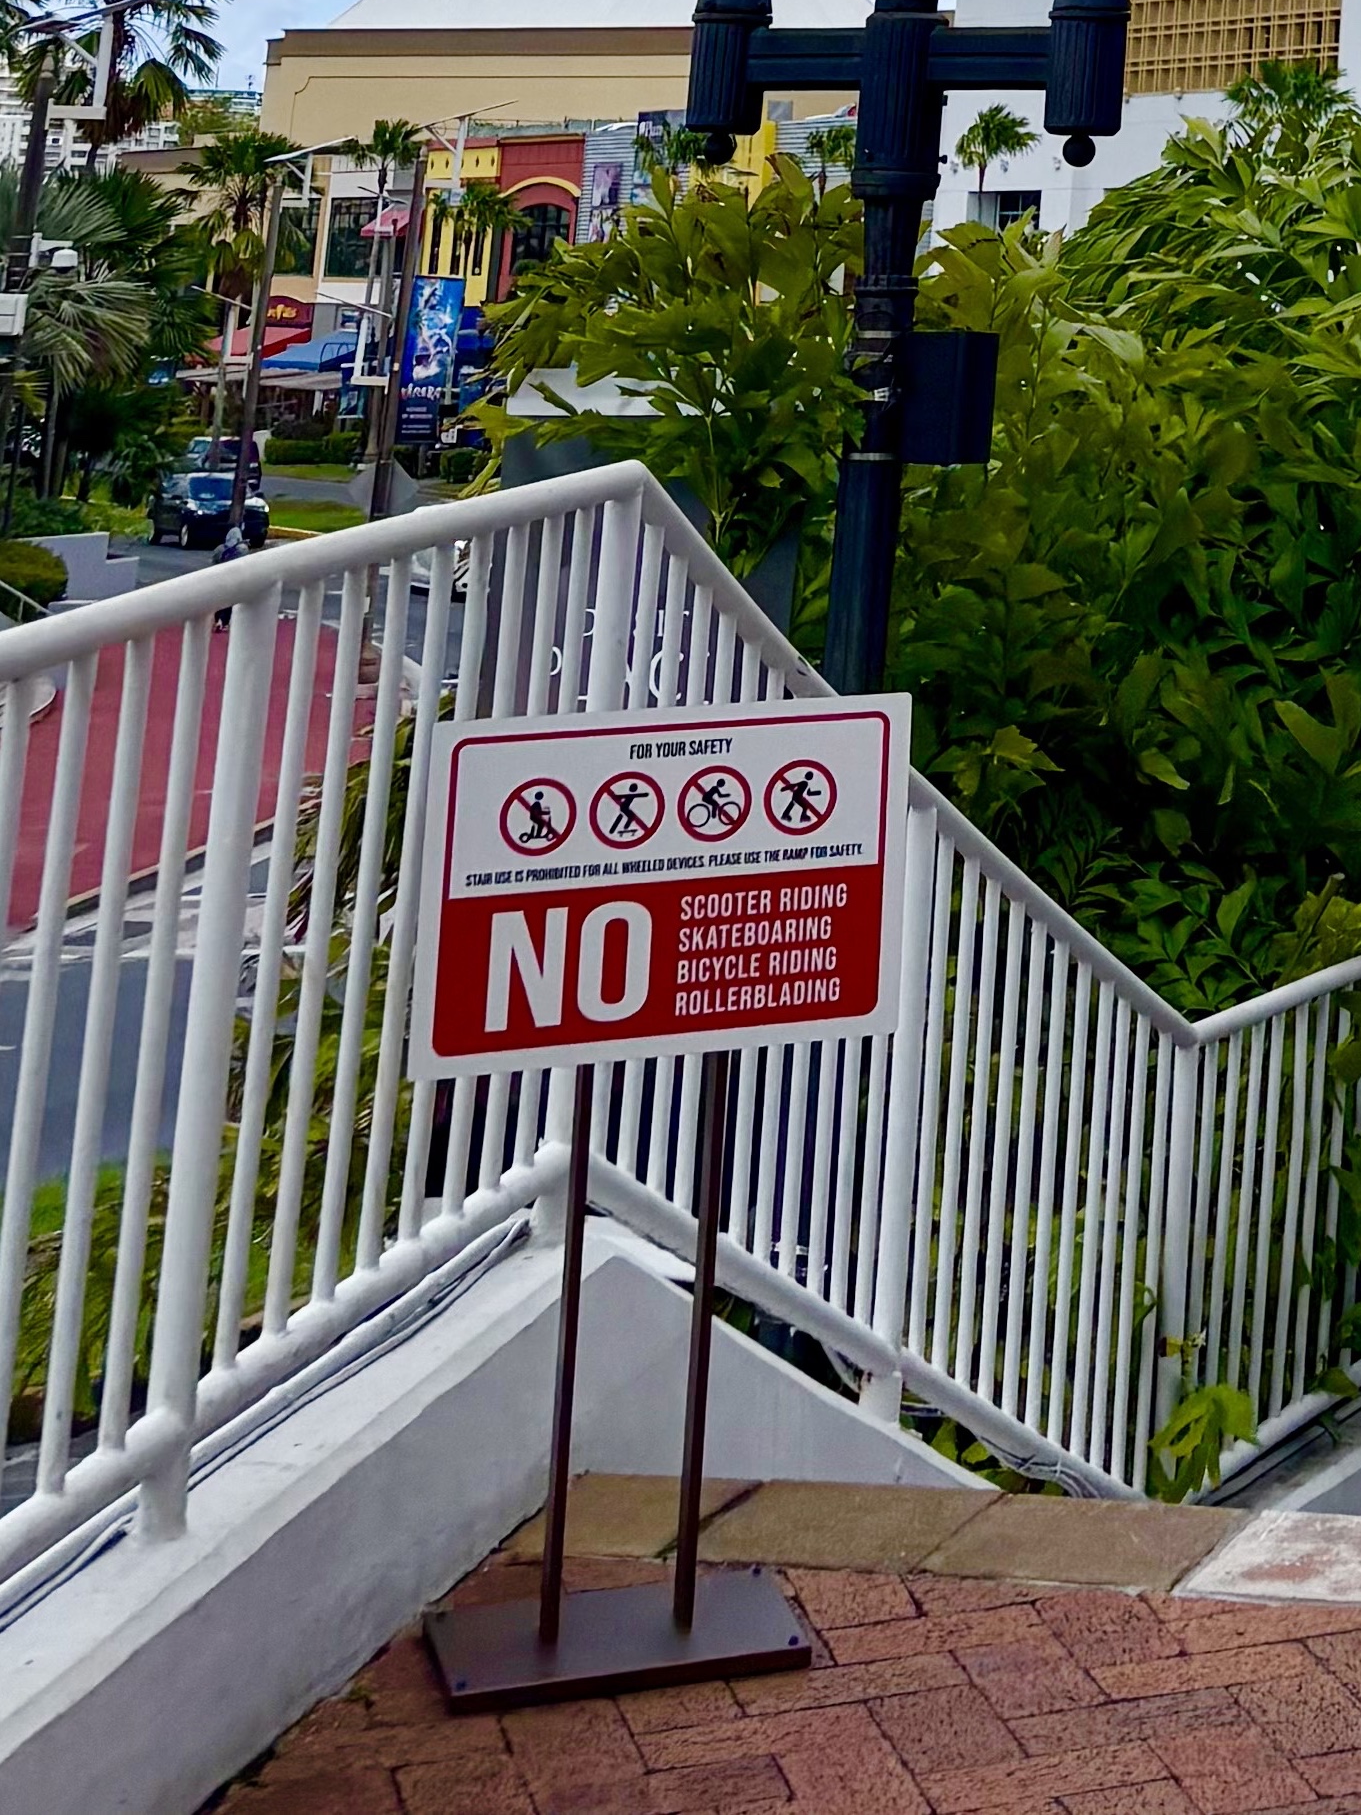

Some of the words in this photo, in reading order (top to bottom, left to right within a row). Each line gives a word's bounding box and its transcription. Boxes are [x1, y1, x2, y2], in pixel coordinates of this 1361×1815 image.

[629, 743, 653, 760] FOR
[655, 741, 686, 758] YOUR
[688, 737, 733, 756] SAFETY
[465, 873, 493, 887] STAIR
[494, 871, 513, 885] USE
[514, 870, 524, 882] IS
[526, 865, 581, 882] PROHIBITED
[582, 864, 601, 877] FOR
[602, 862, 619, 876] ALL
[622, 858, 665, 874] WHEELED
[708, 852, 742, 867] PLEASE
[744, 850, 762, 864] USE
[764, 848, 782, 862] THE
[782, 846, 809, 861] RAMP
[810, 845, 828, 859] FOR
[680, 889, 772, 921] SCOOTER
[779, 882, 848, 913] RIDING
[678, 915, 832, 953] SKATEBOARING
[484, 900, 653, 1033] NO
[676, 952, 761, 984] BICYCLE
[768, 946, 837, 977] RIDING
[674, 977, 841, 1017] ROLLERBLADING
